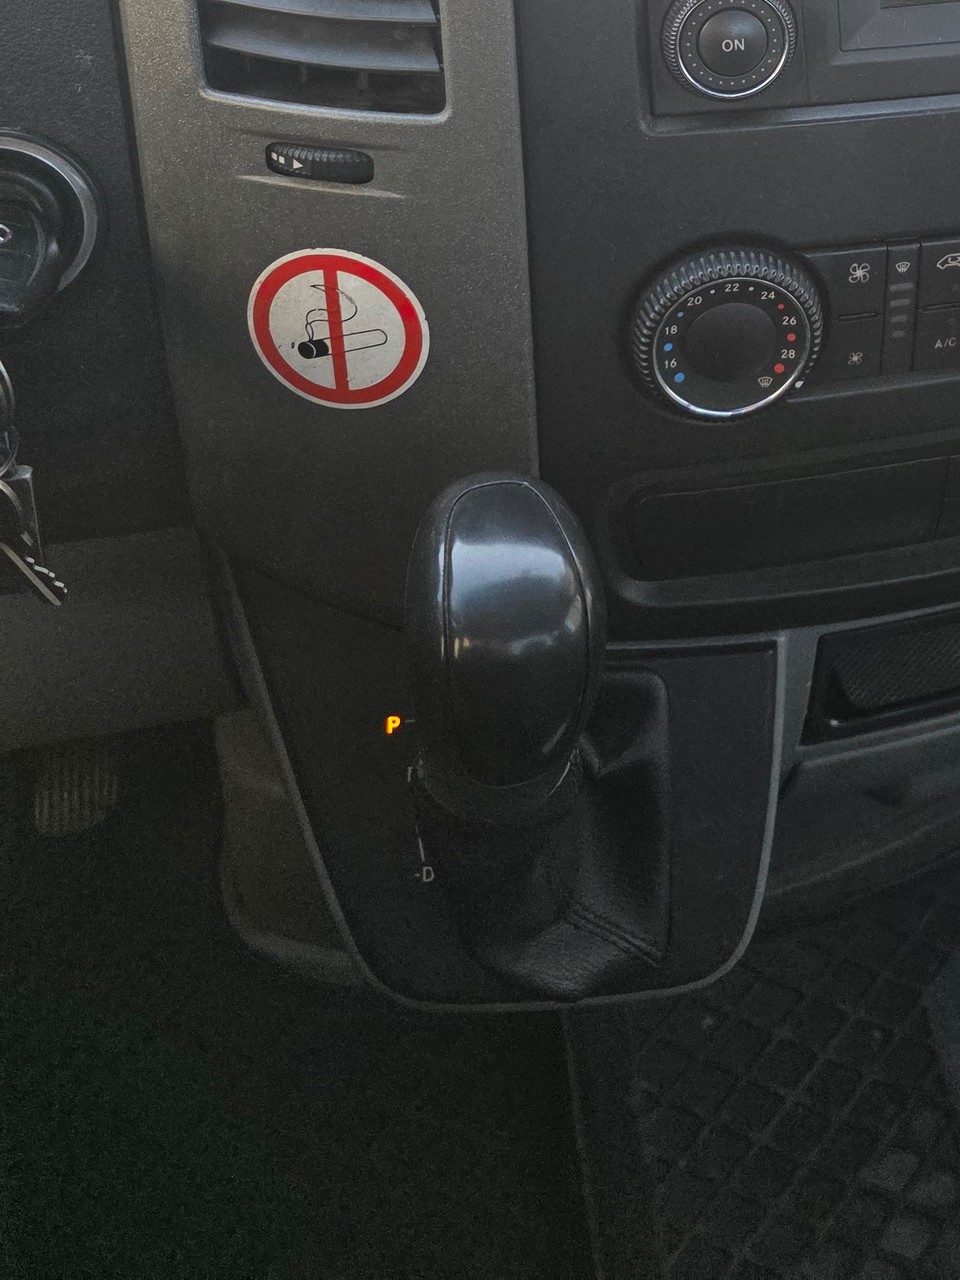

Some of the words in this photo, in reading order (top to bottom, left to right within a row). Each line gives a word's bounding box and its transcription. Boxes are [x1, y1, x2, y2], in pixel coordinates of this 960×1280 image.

[721, 38, 745, 53] ON
[724, 283, 740, 293] 22
[687, 296, 703, 307] 20
[760, 291, 776, 301] 24
[782, 316, 797, 326] 26
[664, 324, 678, 335] 18
[934, 337, 958, 350] A/C
[781, 349, 796, 360] 28
[664, 358, 678, 369] 16
[386, 715, 401, 735] P
